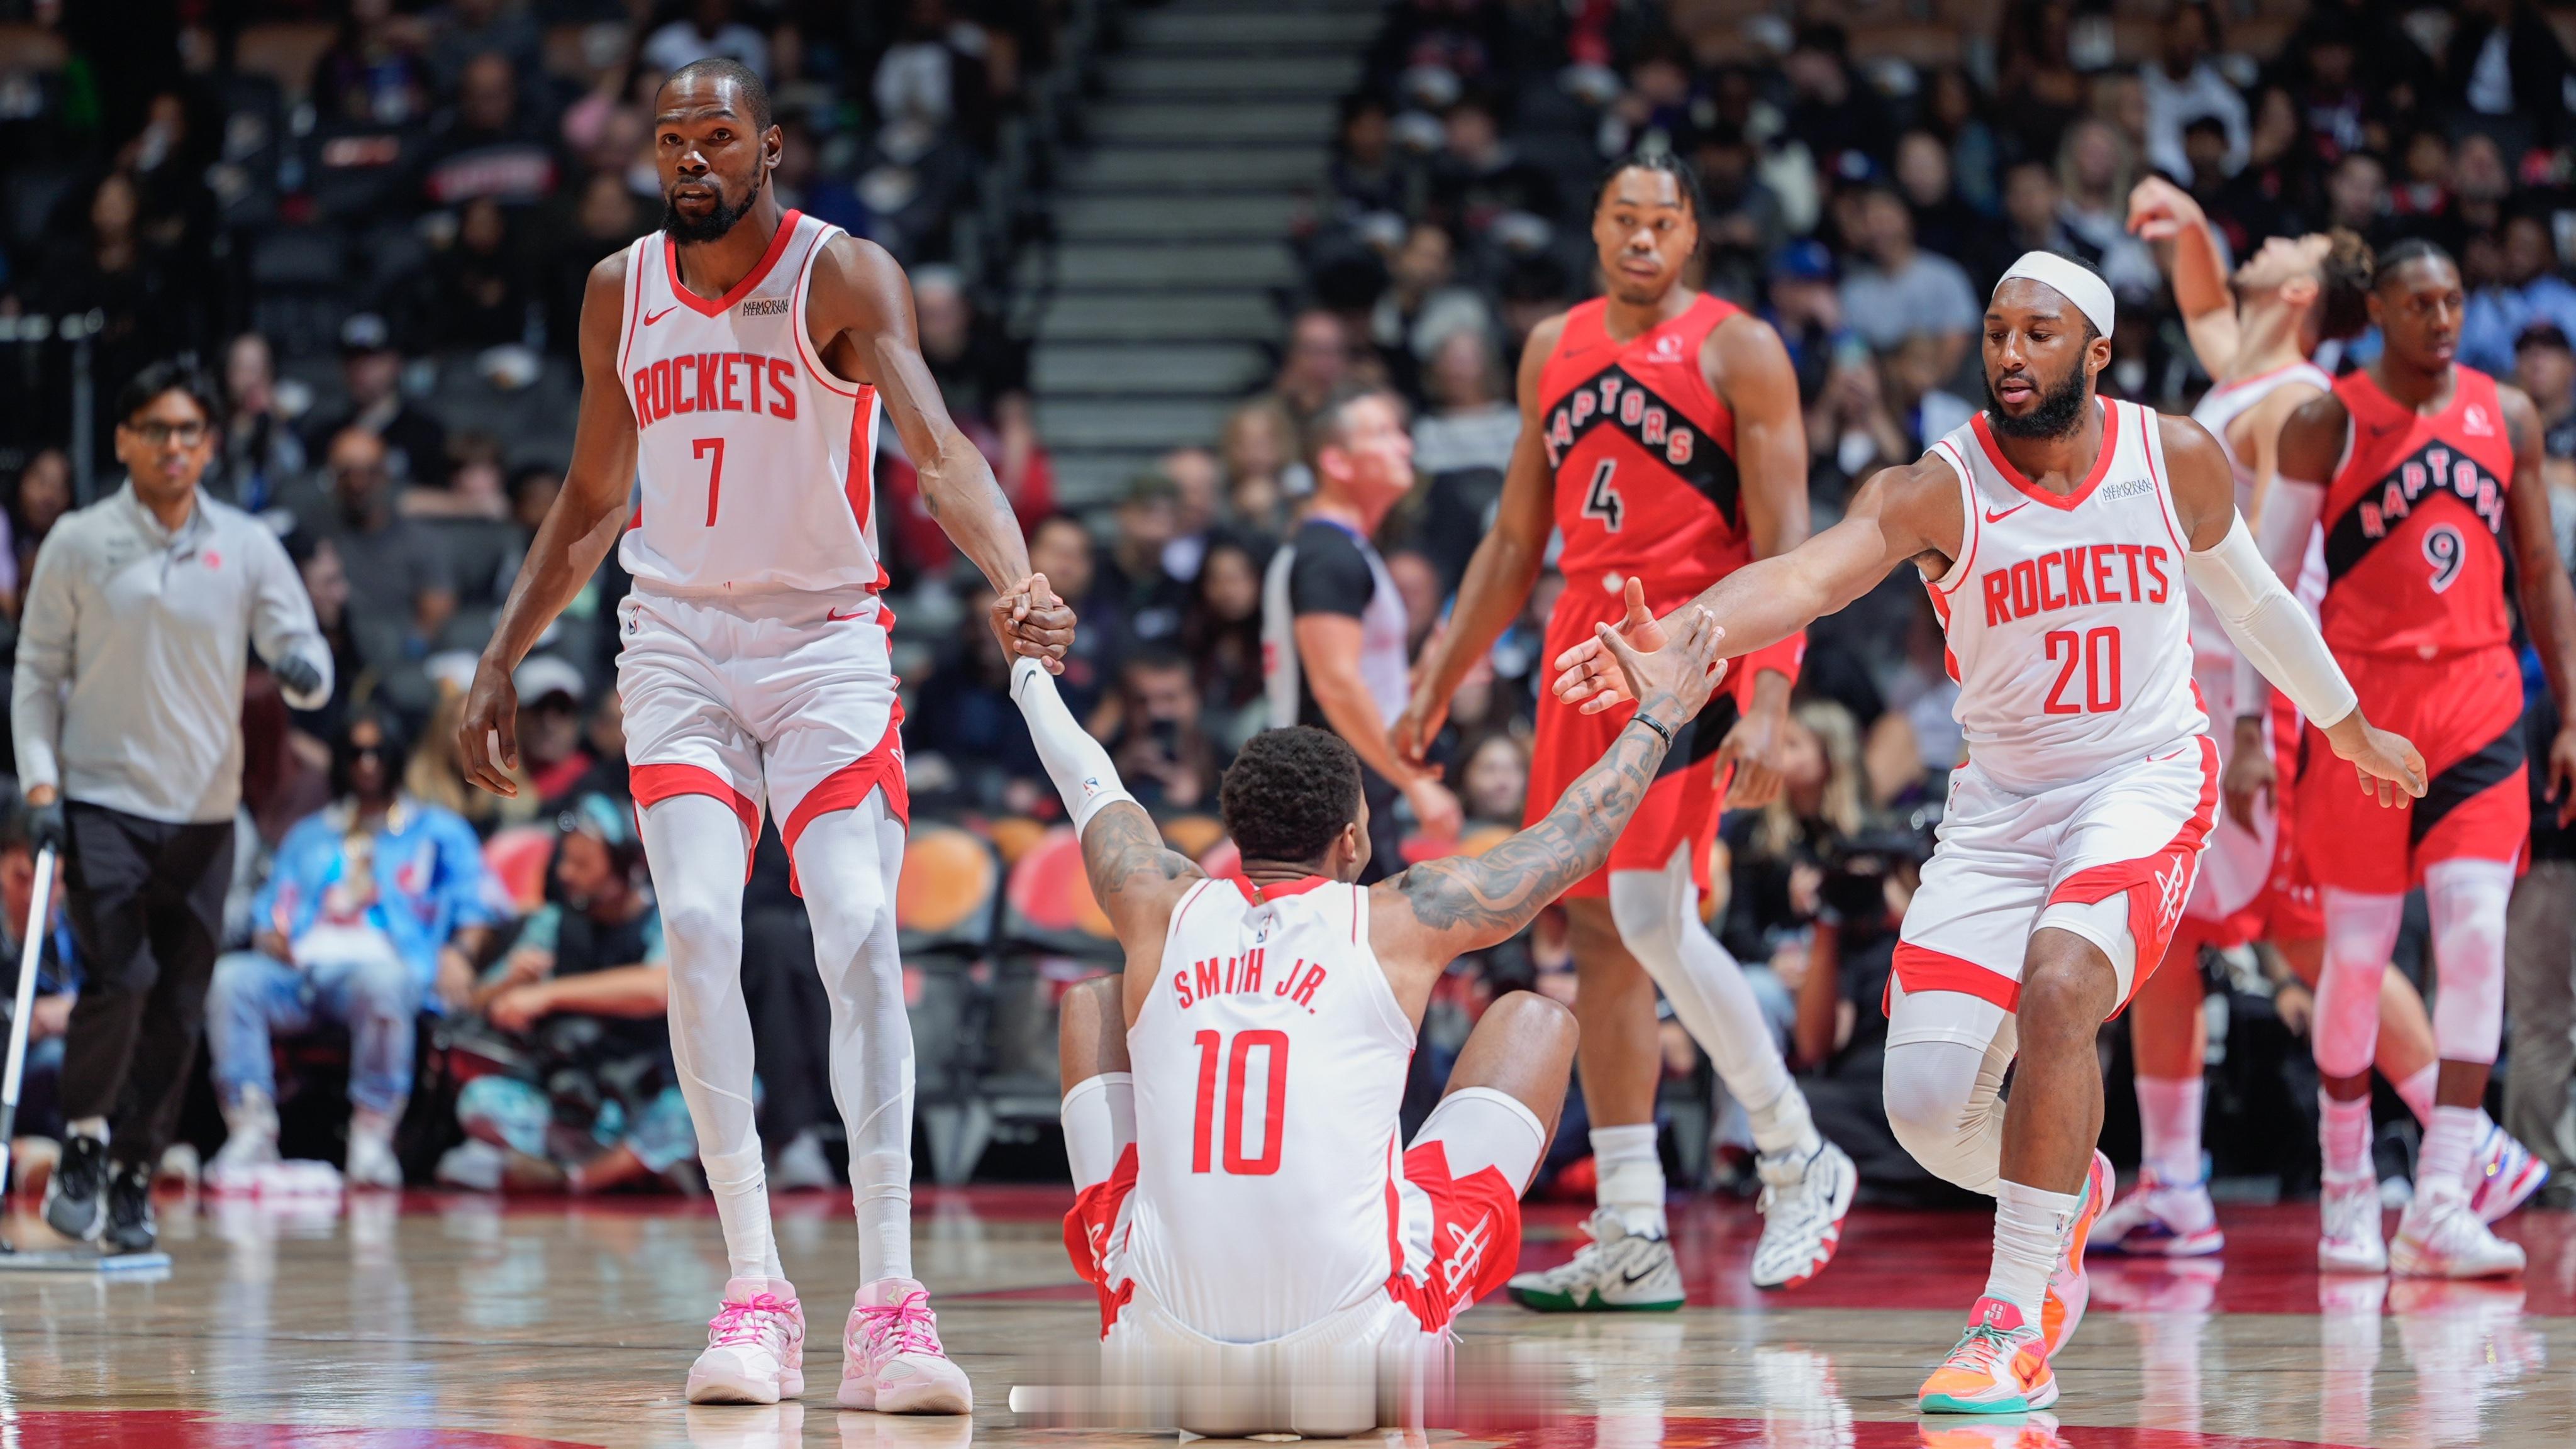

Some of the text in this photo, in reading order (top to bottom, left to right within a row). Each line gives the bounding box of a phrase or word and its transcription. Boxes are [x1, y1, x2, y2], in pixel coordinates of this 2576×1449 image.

[743, 299, 789, 309] MEMORIAL
[743, 304, 789, 316] HERMANN
[633, 352, 797, 432] ROCKETS
[692, 436, 725, 528] 7
[1581, 459, 1624, 533] 4
[2102, 477, 2151, 494] MEMORIAL
[2104, 483, 2153, 501] HERMANN
[1981, 543, 2168, 628] ROCKETS
[2421, 523, 2466, 594] 9
[2043, 625, 2122, 715] 20
[1275, 958, 1326, 1014] JR.
[1192, 1028, 1290, 1176] 10
